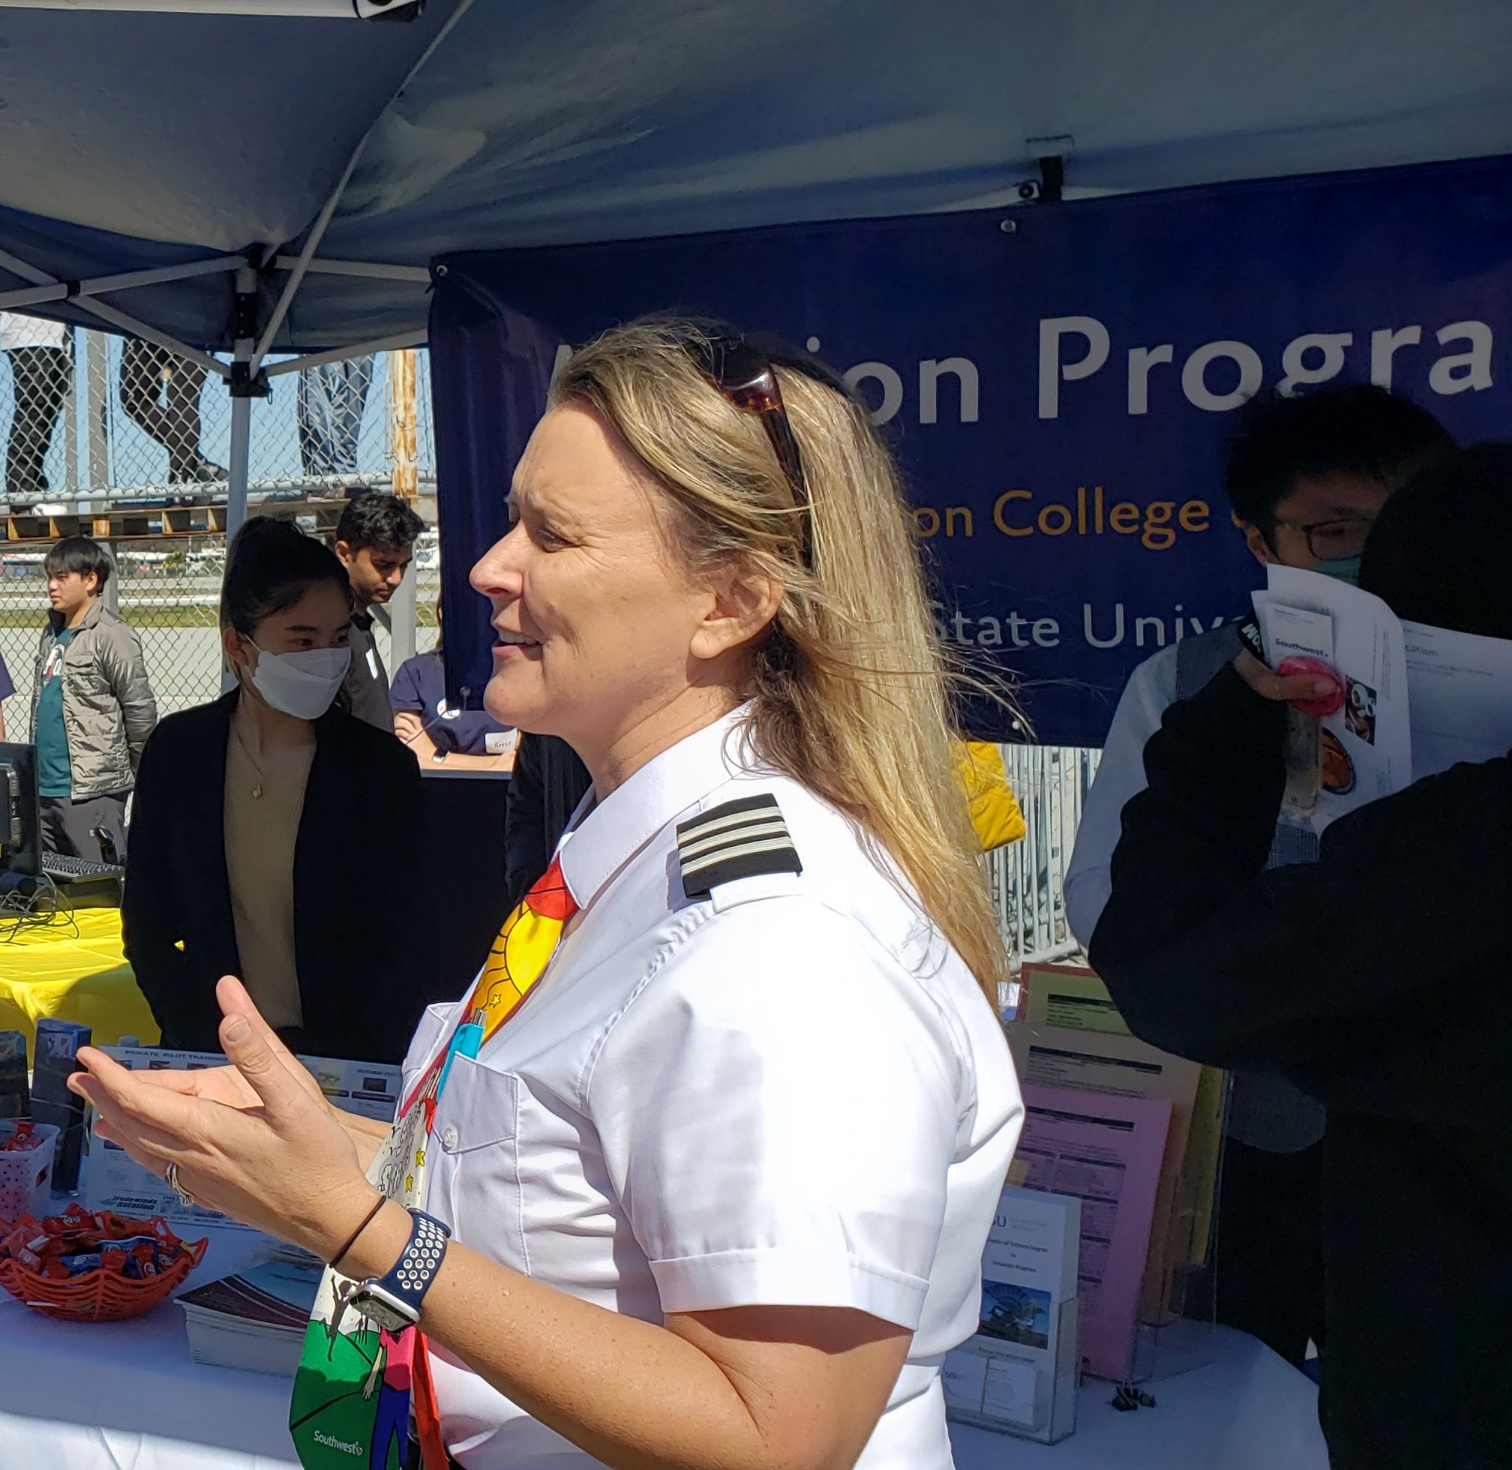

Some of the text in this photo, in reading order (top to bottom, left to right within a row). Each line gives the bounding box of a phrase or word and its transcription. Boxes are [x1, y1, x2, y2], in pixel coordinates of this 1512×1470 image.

[992, 486, 1210, 550] College
[1083, 603, 1246, 649] Univ
[1275, 638, 1324, 657] Southwest
[1404, 644, 1439, 657] cation
[125, 1049, 159, 1057] PRIVATE
[116, 1201, 156, 1211] aviation
[313, 1430, 356, 1455] Southwest
